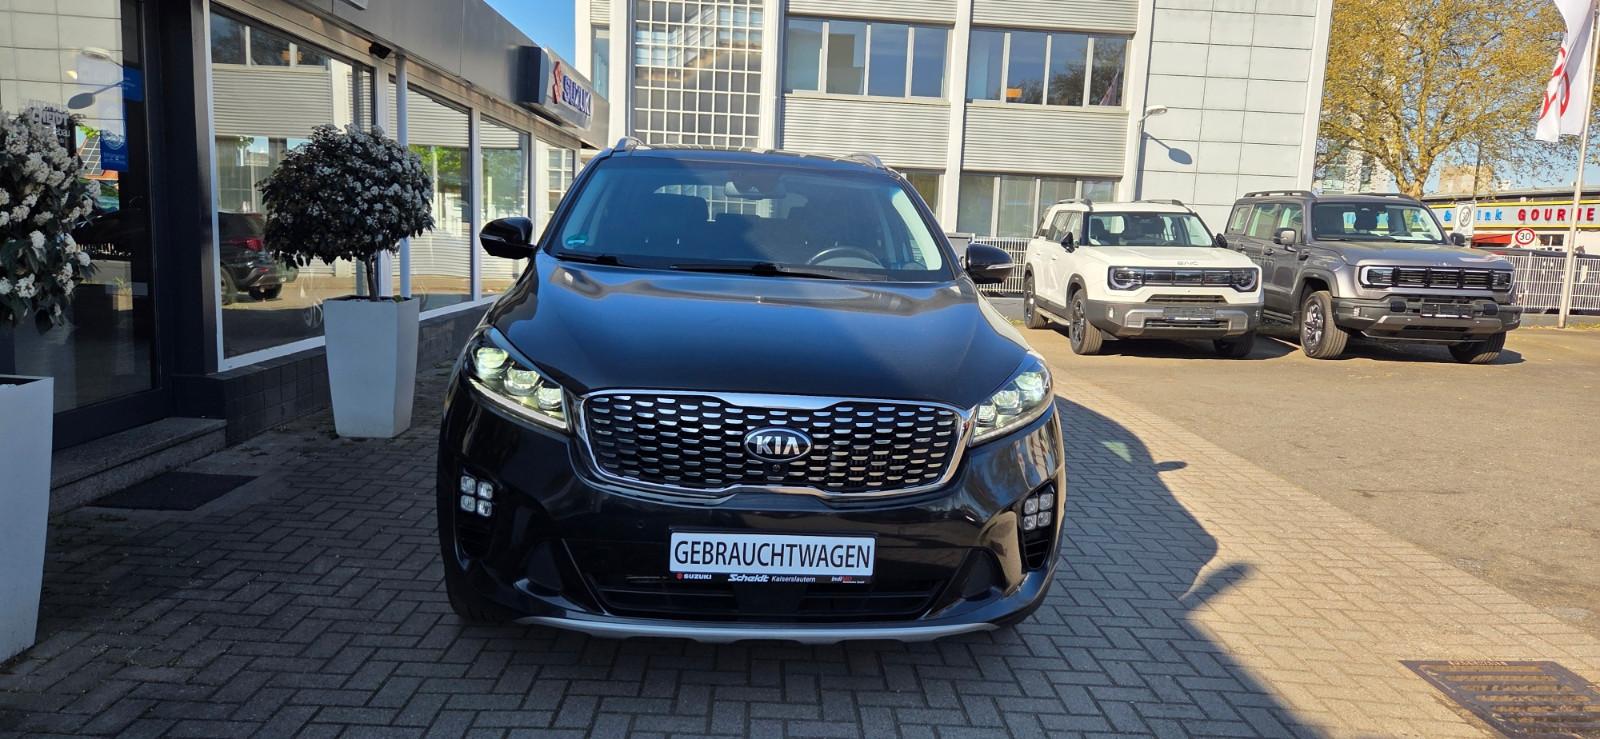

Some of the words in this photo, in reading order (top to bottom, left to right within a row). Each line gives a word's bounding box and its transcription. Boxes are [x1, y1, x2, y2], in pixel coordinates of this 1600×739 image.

[562, 75, 592, 116] SUZUKI
[1519, 232, 1531, 241] 30
[756, 435, 800, 455] KIA
[674, 540, 871, 569] GEBRAUCHTWAGEN
[771, 575, 816, 583] Kaiserslautern
